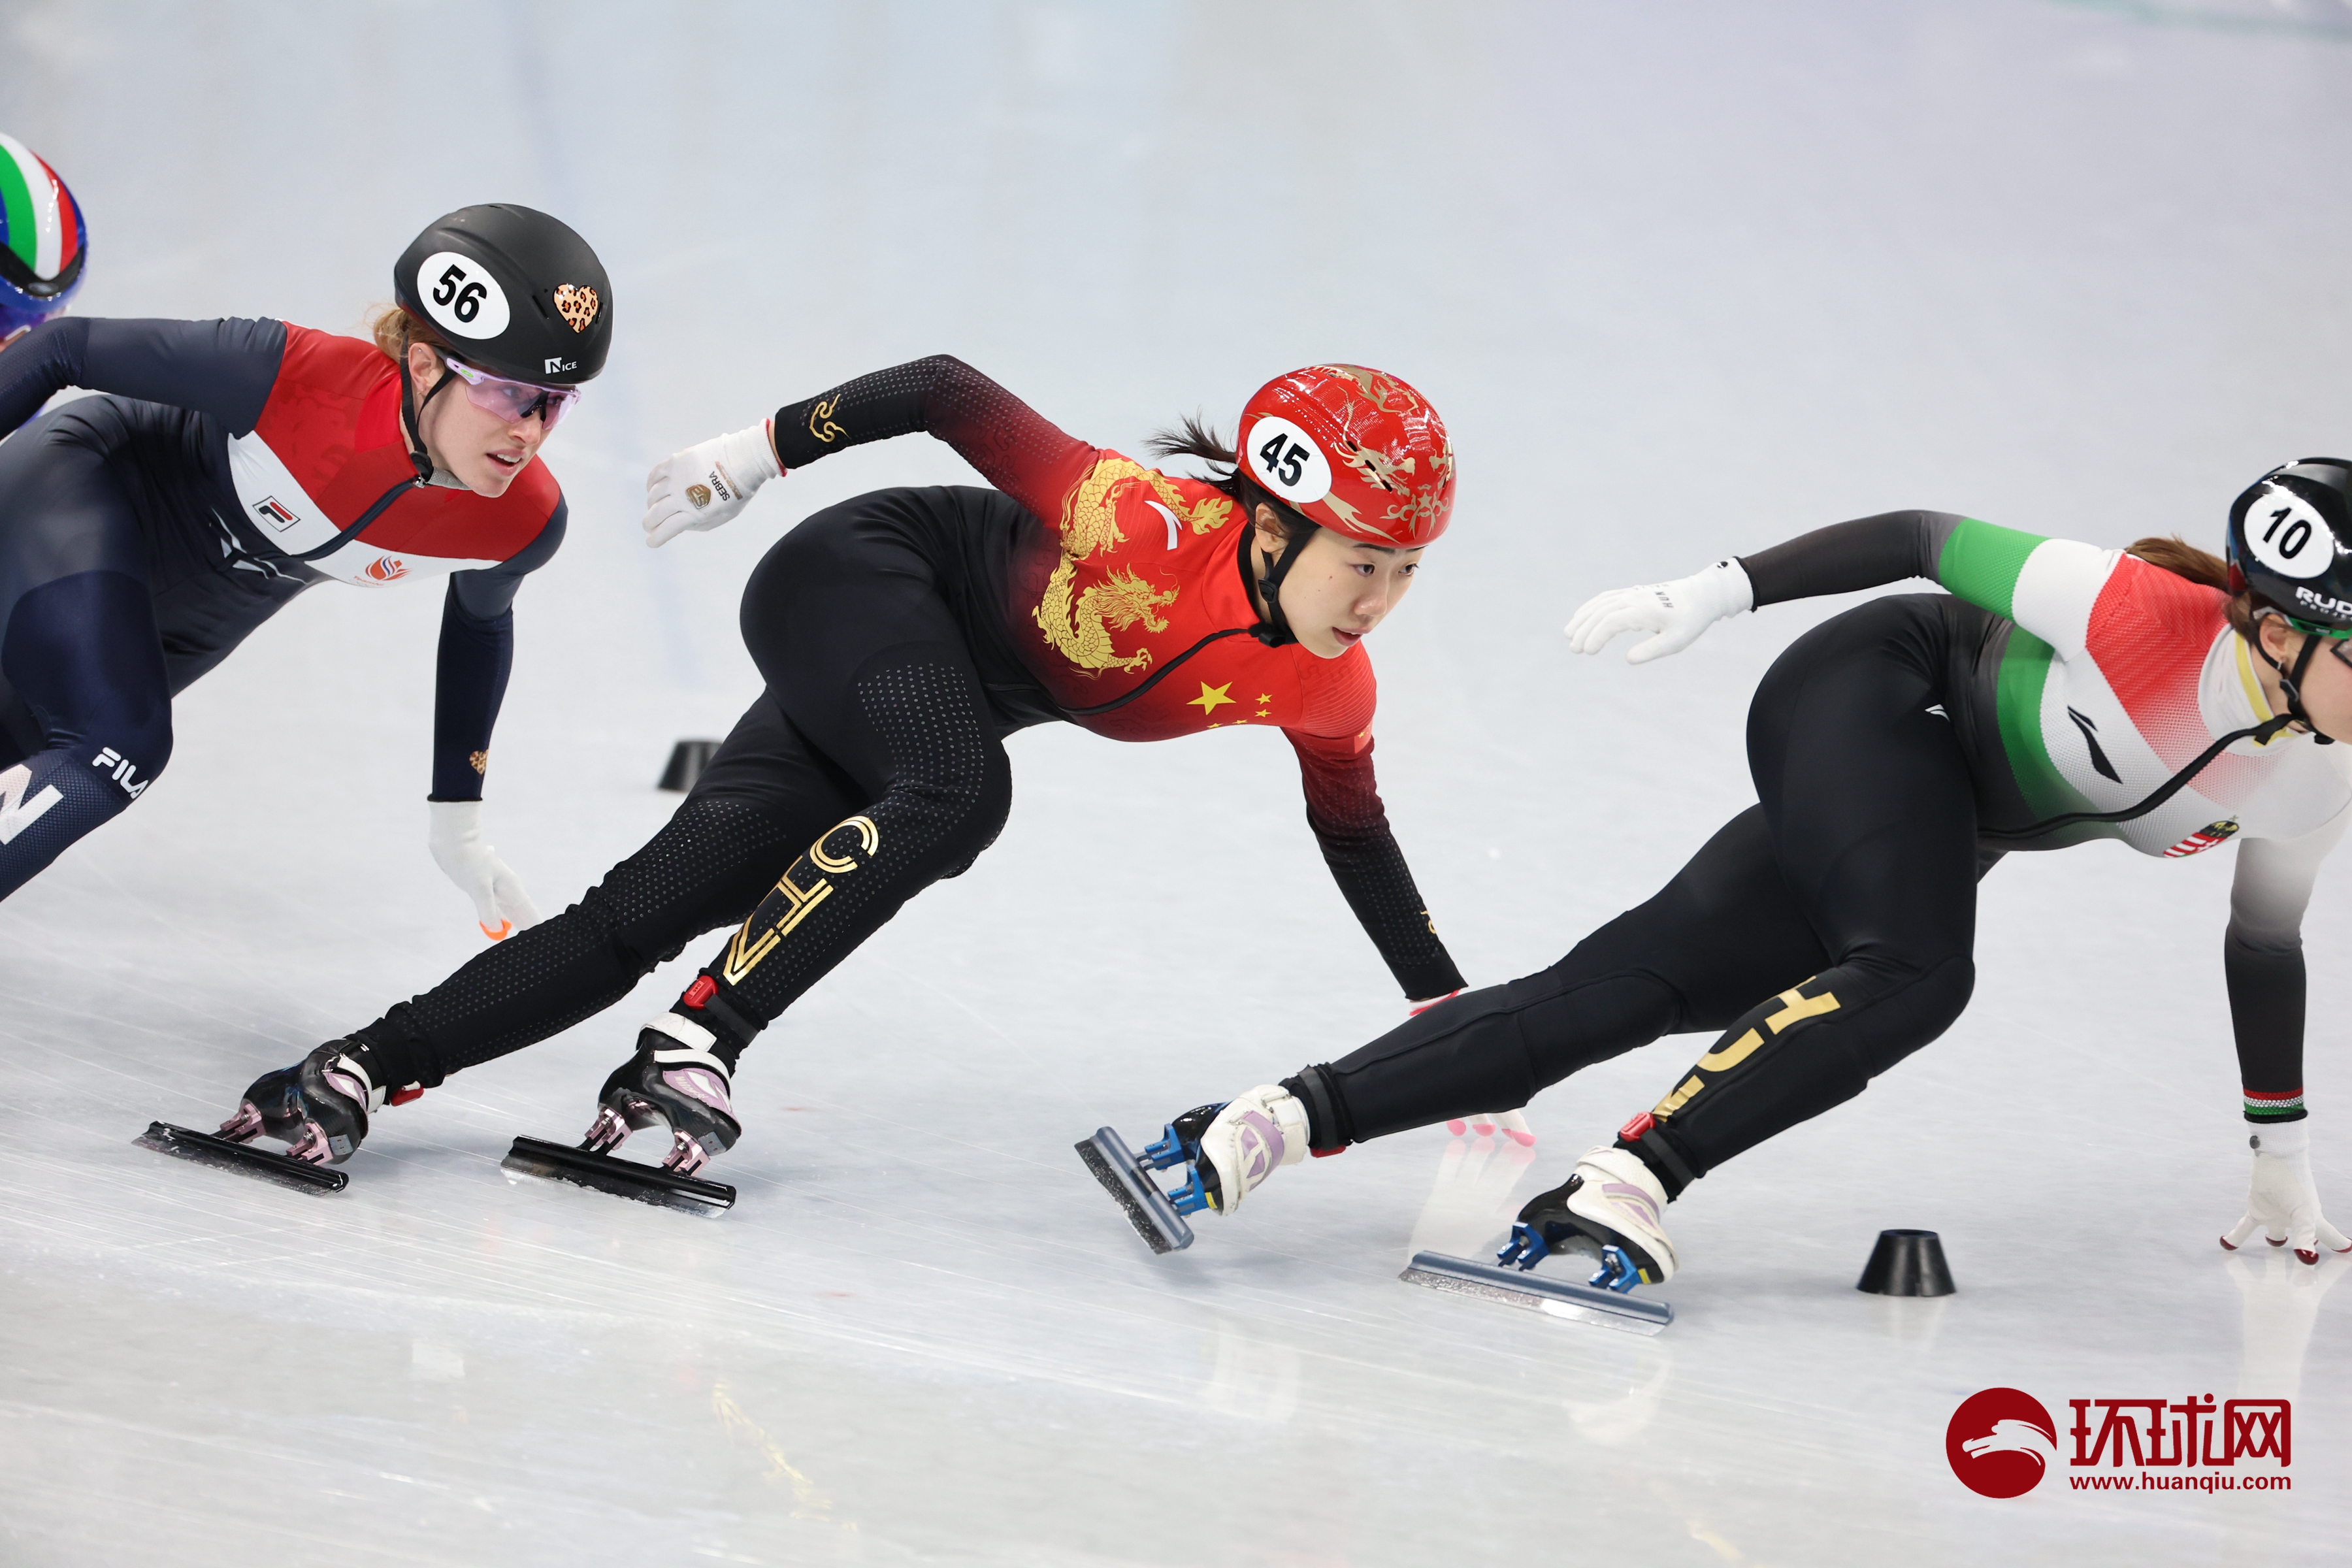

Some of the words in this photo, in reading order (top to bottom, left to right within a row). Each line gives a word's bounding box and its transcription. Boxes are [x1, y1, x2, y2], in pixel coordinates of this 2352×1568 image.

[433, 264, 487, 323] 56
[544, 357, 578, 374] NICE
[1260, 433, 1311, 486] 45
[709, 471, 730, 501] SEBRA
[2262, 507, 2312, 559] 10
[92, 747, 149, 799] FILA
